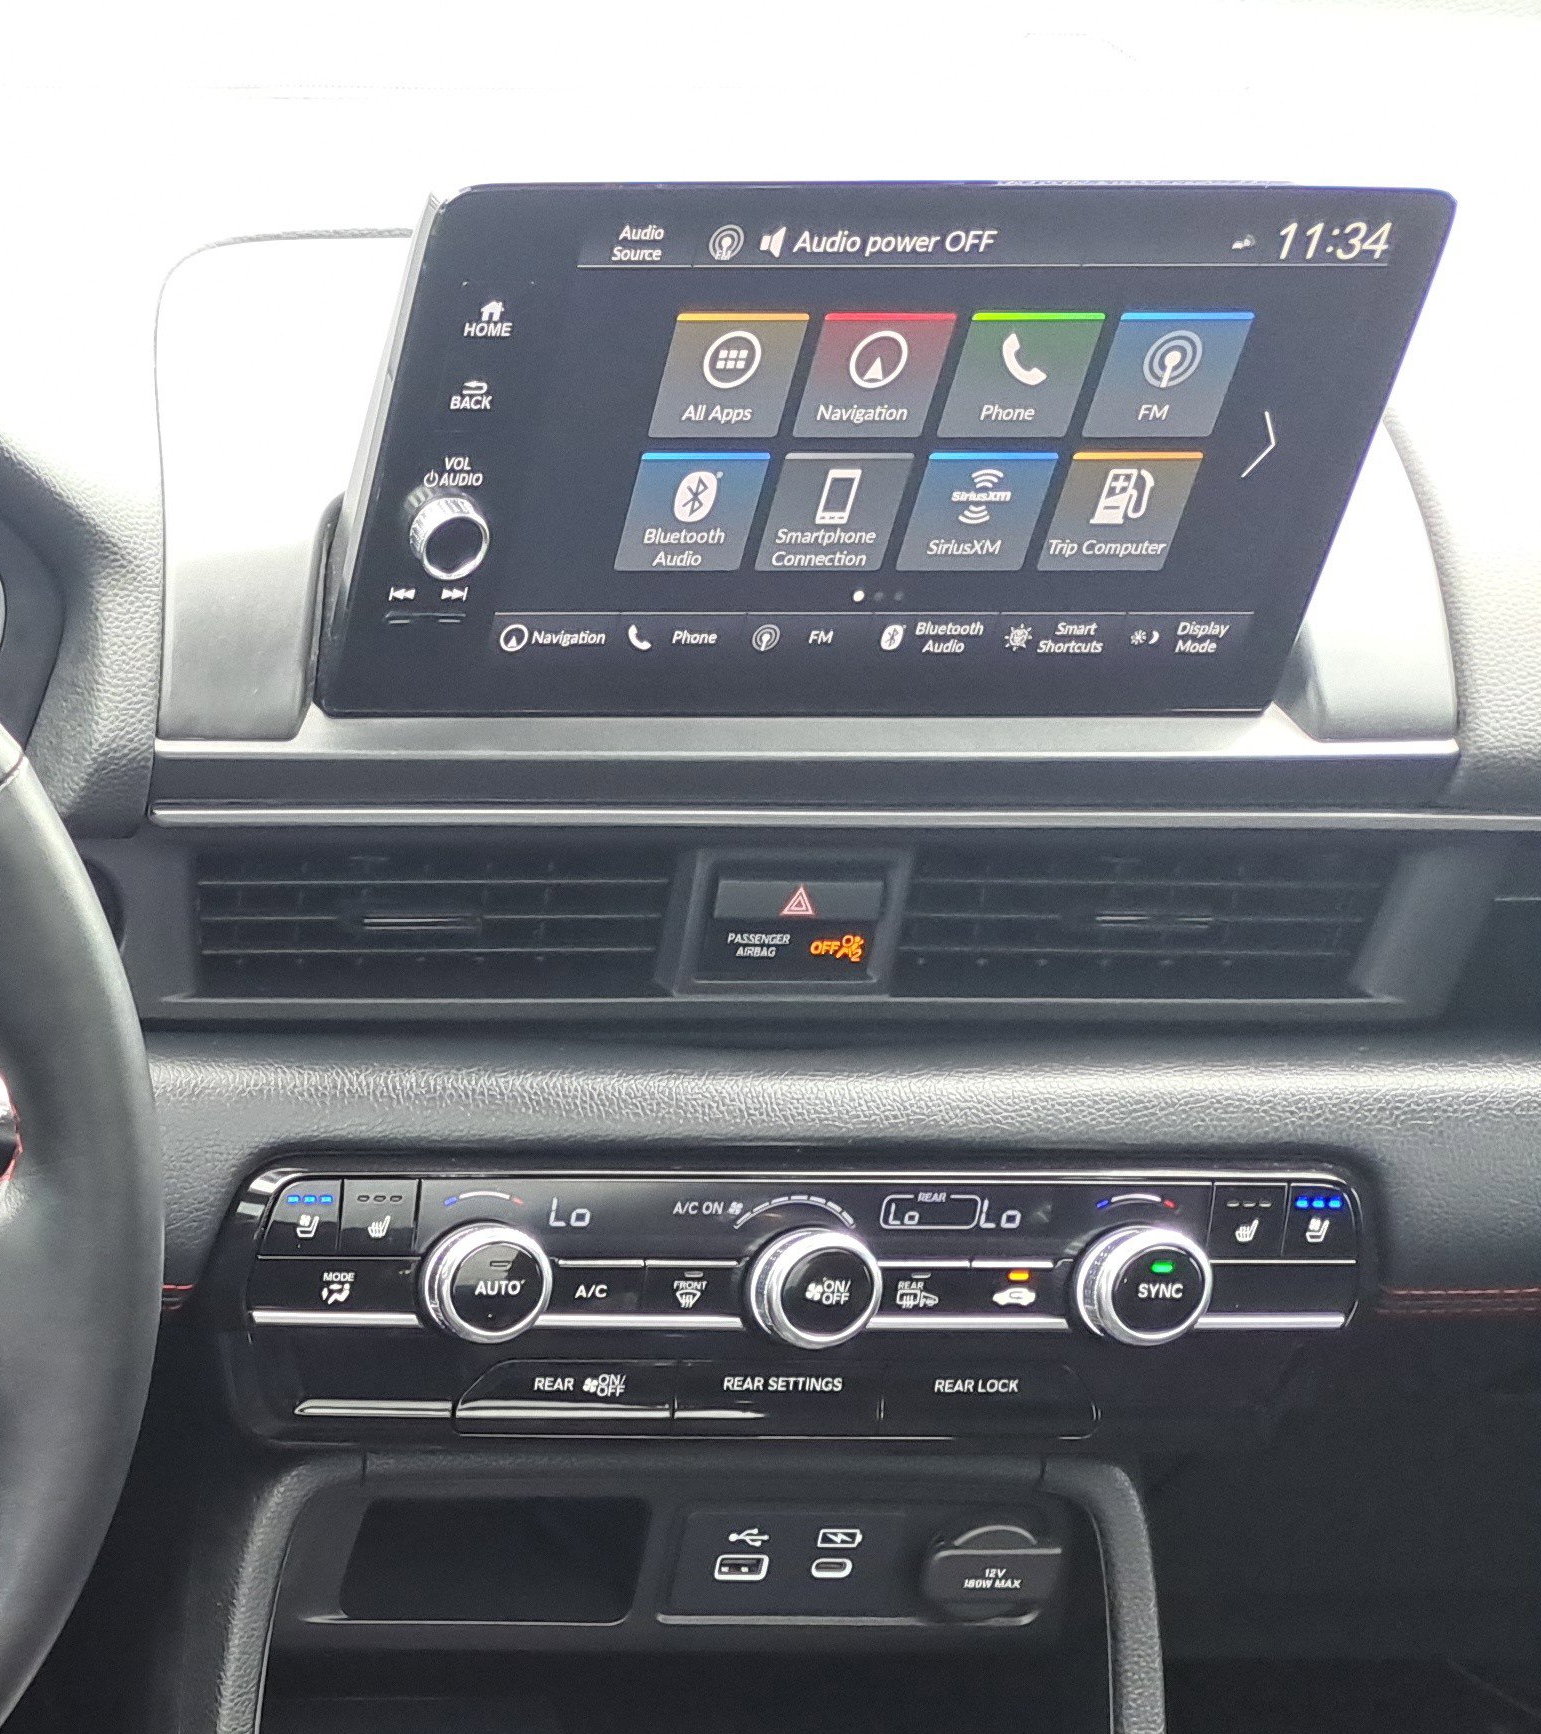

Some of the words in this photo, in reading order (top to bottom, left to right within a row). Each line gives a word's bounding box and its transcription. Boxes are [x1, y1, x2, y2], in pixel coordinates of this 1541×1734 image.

[618, 225, 665, 241] Audio
[1278, 220, 1393, 260] 11:34
[793, 230, 861, 253] Audio
[864, 234, 940, 257] power
[944, 230, 998, 253] OFF
[611, 246, 662, 261] Source
[463, 322, 513, 337] HOME
[449, 395, 493, 410] BACK
[681, 404, 706, 421] All
[708, 404, 753, 424] Apps
[816, 404, 909, 425] Navigation
[979, 404, 1035, 421] Phone
[1137, 404, 1170, 421] FM
[444, 456, 472, 471] VOL
[439, 472, 483, 487] AUDIO
[643, 528, 725, 545] Bluetooth
[775, 528, 877, 549] Smartphone
[926, 539, 1002, 555] SiriusXM
[1048, 539, 1077, 558] Trip
[1082, 539, 1167, 558] Computer
[652, 551, 702, 567] Audio
[771, 551, 867, 567] Connection
[915, 621, 984, 636] Bluetooth
[1054, 621, 1098, 636] Smart
[1176, 621, 1231, 638] Display
[531, 629, 606, 646] Navigation
[671, 629, 718, 645] Phone
[807, 629, 834, 645] FM
[922, 639, 965, 653] Audio
[1036, 639, 1104, 654] Shortcuts
[1174, 639, 1217, 654] Mode
[727, 932, 791, 945] PASSENGER
[735, 946, 777, 957] AIRBAG
[810, 940, 840, 955] OFF
[917, 1191, 947, 1203] REAR
[548, 1197, 592, 1227] Lo
[673, 1201, 700, 1215] A/C
[702, 1201, 724, 1215] ON
[888, 1203, 920, 1225] Lo
[979, 1198, 1022, 1228] Lo
[322, 1271, 355, 1282] MODE
[474, 1280, 521, 1296] AUTO
[574, 1283, 608, 1299] A/C
[673, 1280, 708, 1291] FRONT
[822, 1279, 852, 1293] ON/
[897, 1281, 925, 1291] REAR
[1137, 1283, 1184, 1299] SYNC
[822, 1292, 850, 1306] OFF
[533, 1377, 574, 1391] REAR
[597, 1373, 627, 1386] ON/
[723, 1377, 763, 1391] REAR
[767, 1377, 843, 1392] SETTINGS
[934, 1378, 975, 1393] REAR
[977, 1378, 1019, 1393] LOCK
[596, 1385, 626, 1397] OFF
[985, 1568, 1007, 1578] 12V
[994, 1579, 1022, 1589] MAX
